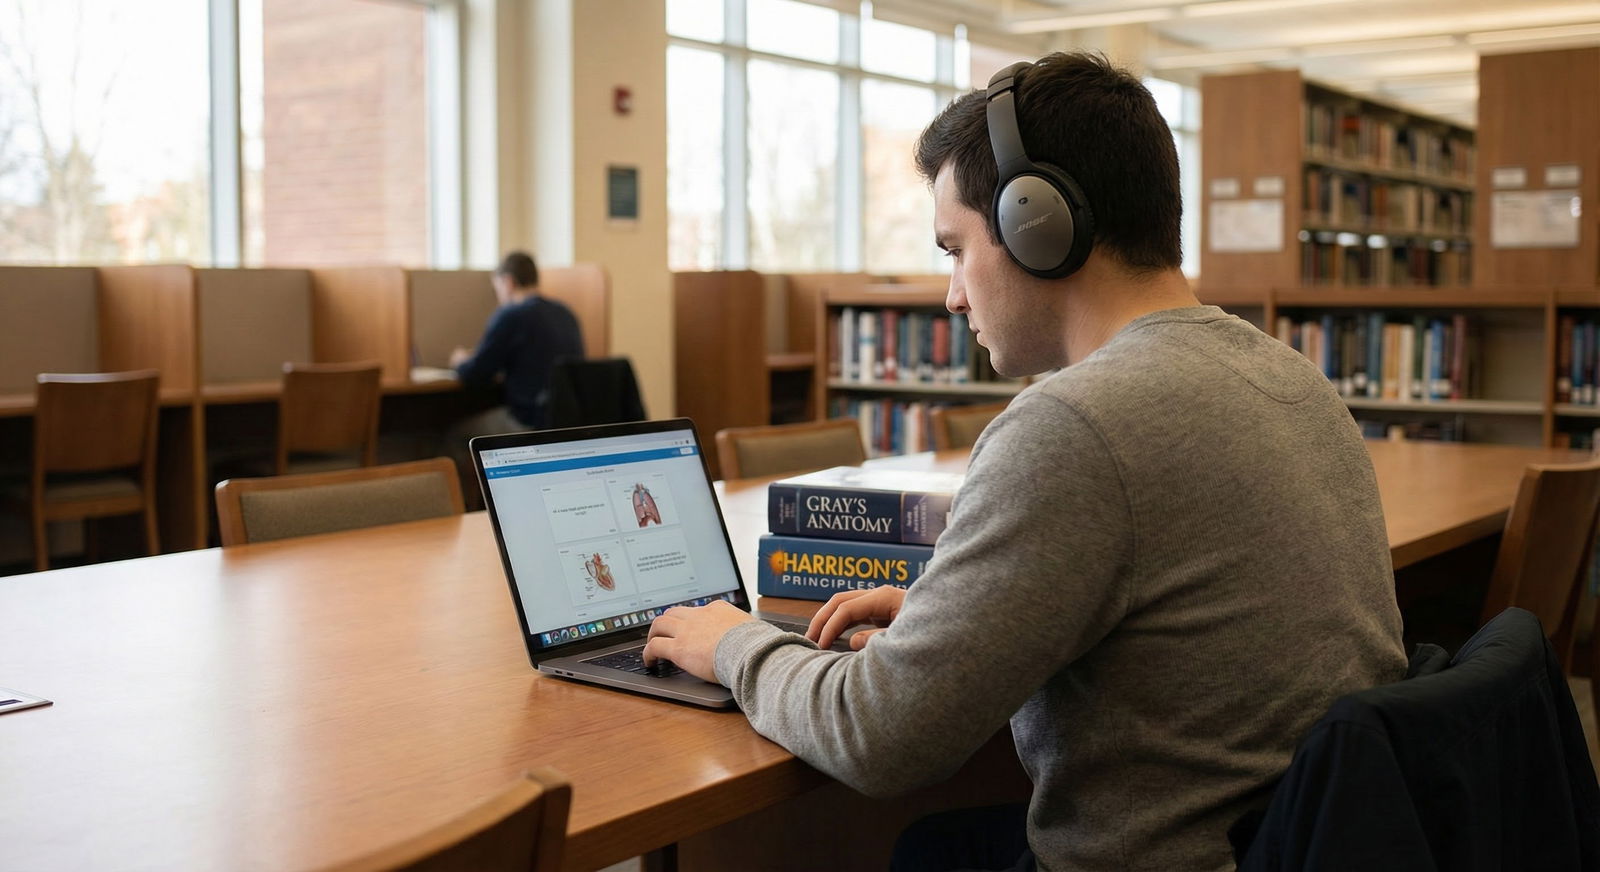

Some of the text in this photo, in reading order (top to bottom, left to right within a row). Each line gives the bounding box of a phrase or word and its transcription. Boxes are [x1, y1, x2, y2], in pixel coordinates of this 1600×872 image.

[806, 495, 867, 515] GRAY'S
[806, 514, 892, 534] ANATOMY
[783, 552, 909, 582] HARRISON'S
[782, 575, 876, 589] PRINCIPLES
